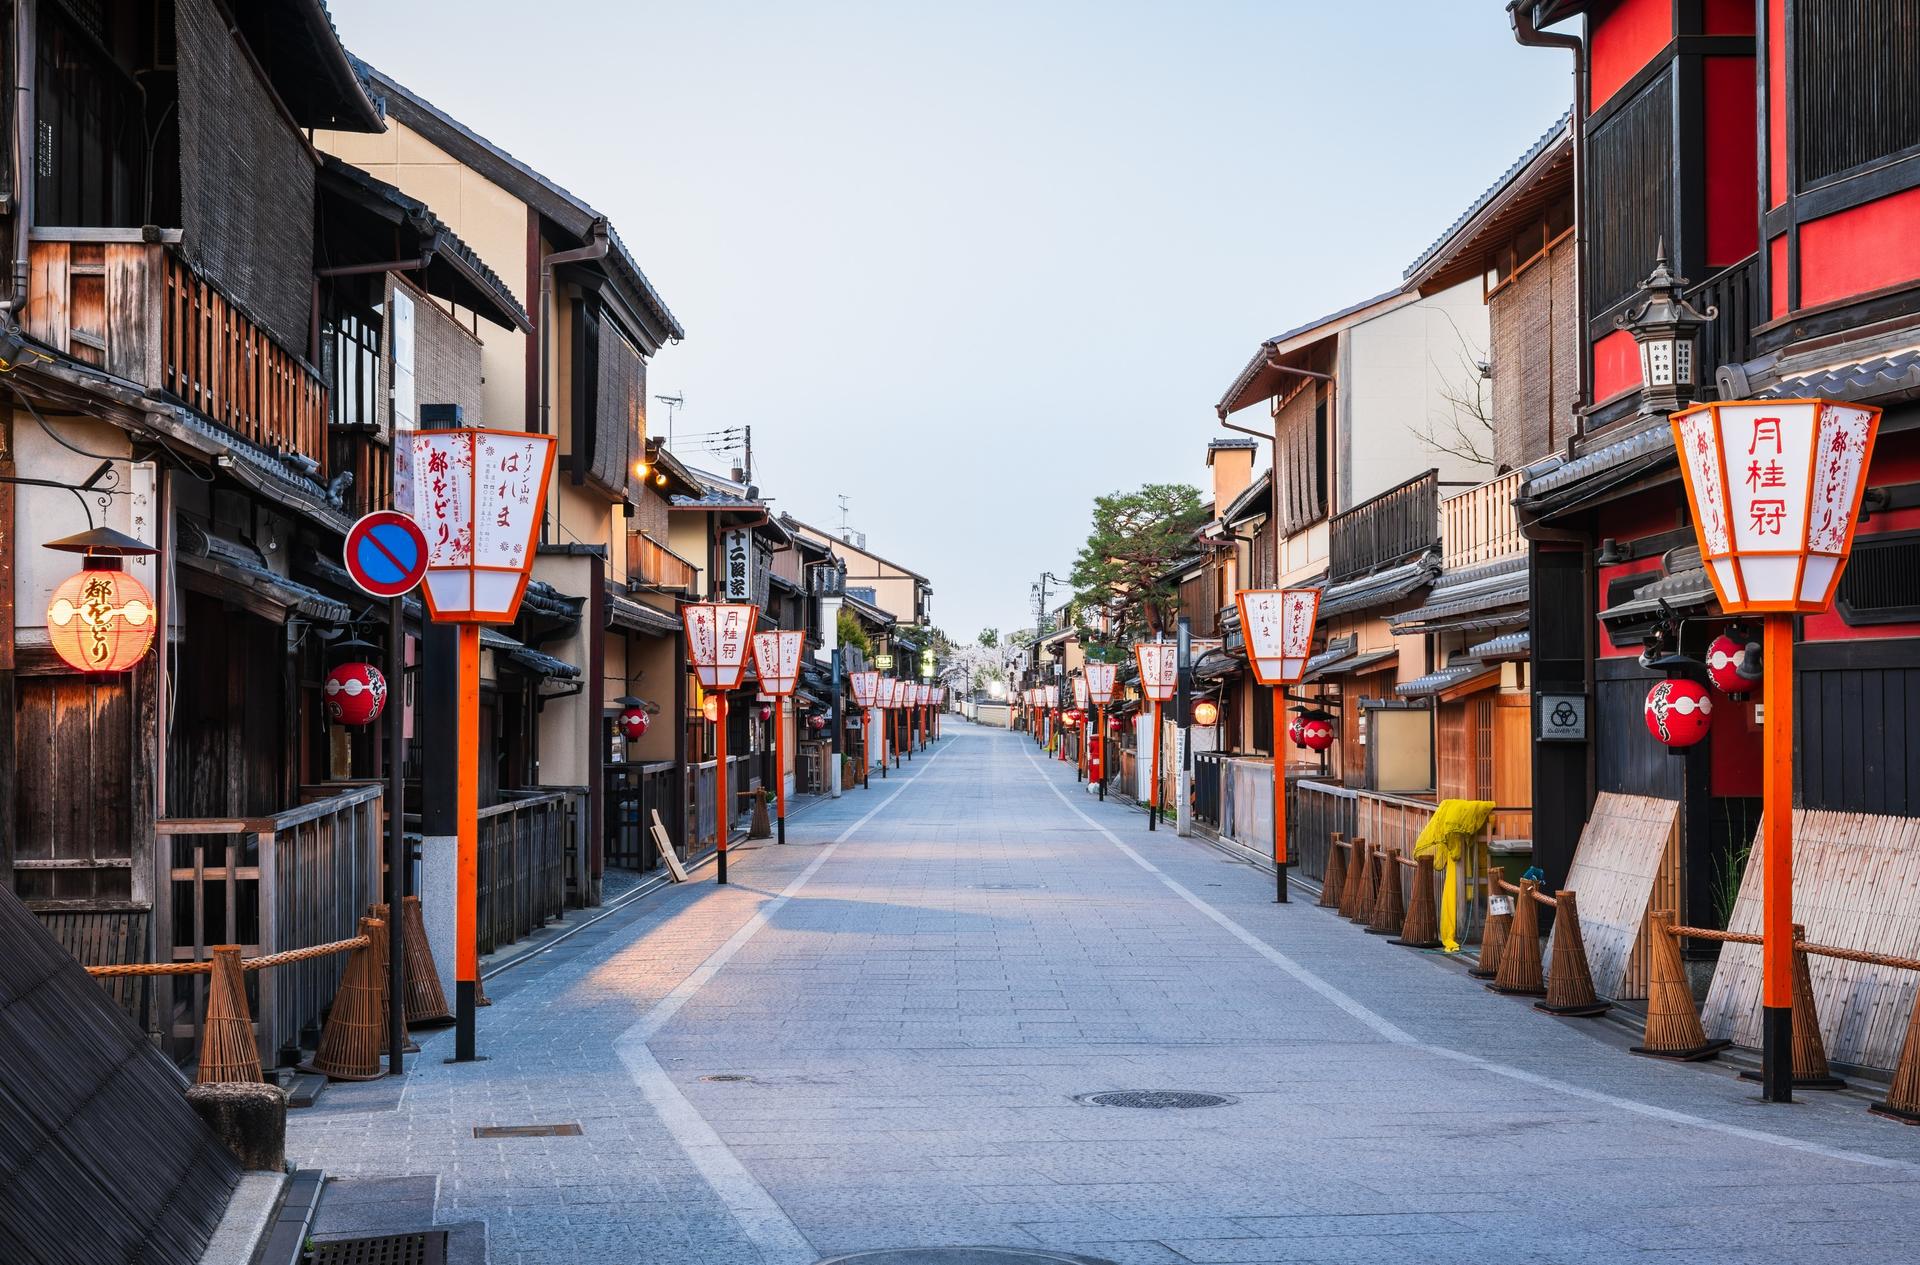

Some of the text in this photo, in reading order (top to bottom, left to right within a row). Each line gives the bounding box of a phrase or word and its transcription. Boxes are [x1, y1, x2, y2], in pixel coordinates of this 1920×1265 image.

[428, 448, 450, 546] 都をどり
[496, 451, 520, 527] はれま
[519, 443, 534, 505] チリメン山椒
[1697, 429, 1719, 533] 都をどり
[1745, 417, 1787, 536] 月桂冠
[1820, 425, 1849, 531] 都をどり
[84, 578, 113, 664] 都をどり
[696, 615, 707, 657] 都をどり
[722, 611, 738, 659] 月桂冠
[1293, 599, 1304, 647] 都をどり
[1163, 649, 1175, 681] 月桂冠
[1654, 683, 1672, 741] 都をどり
